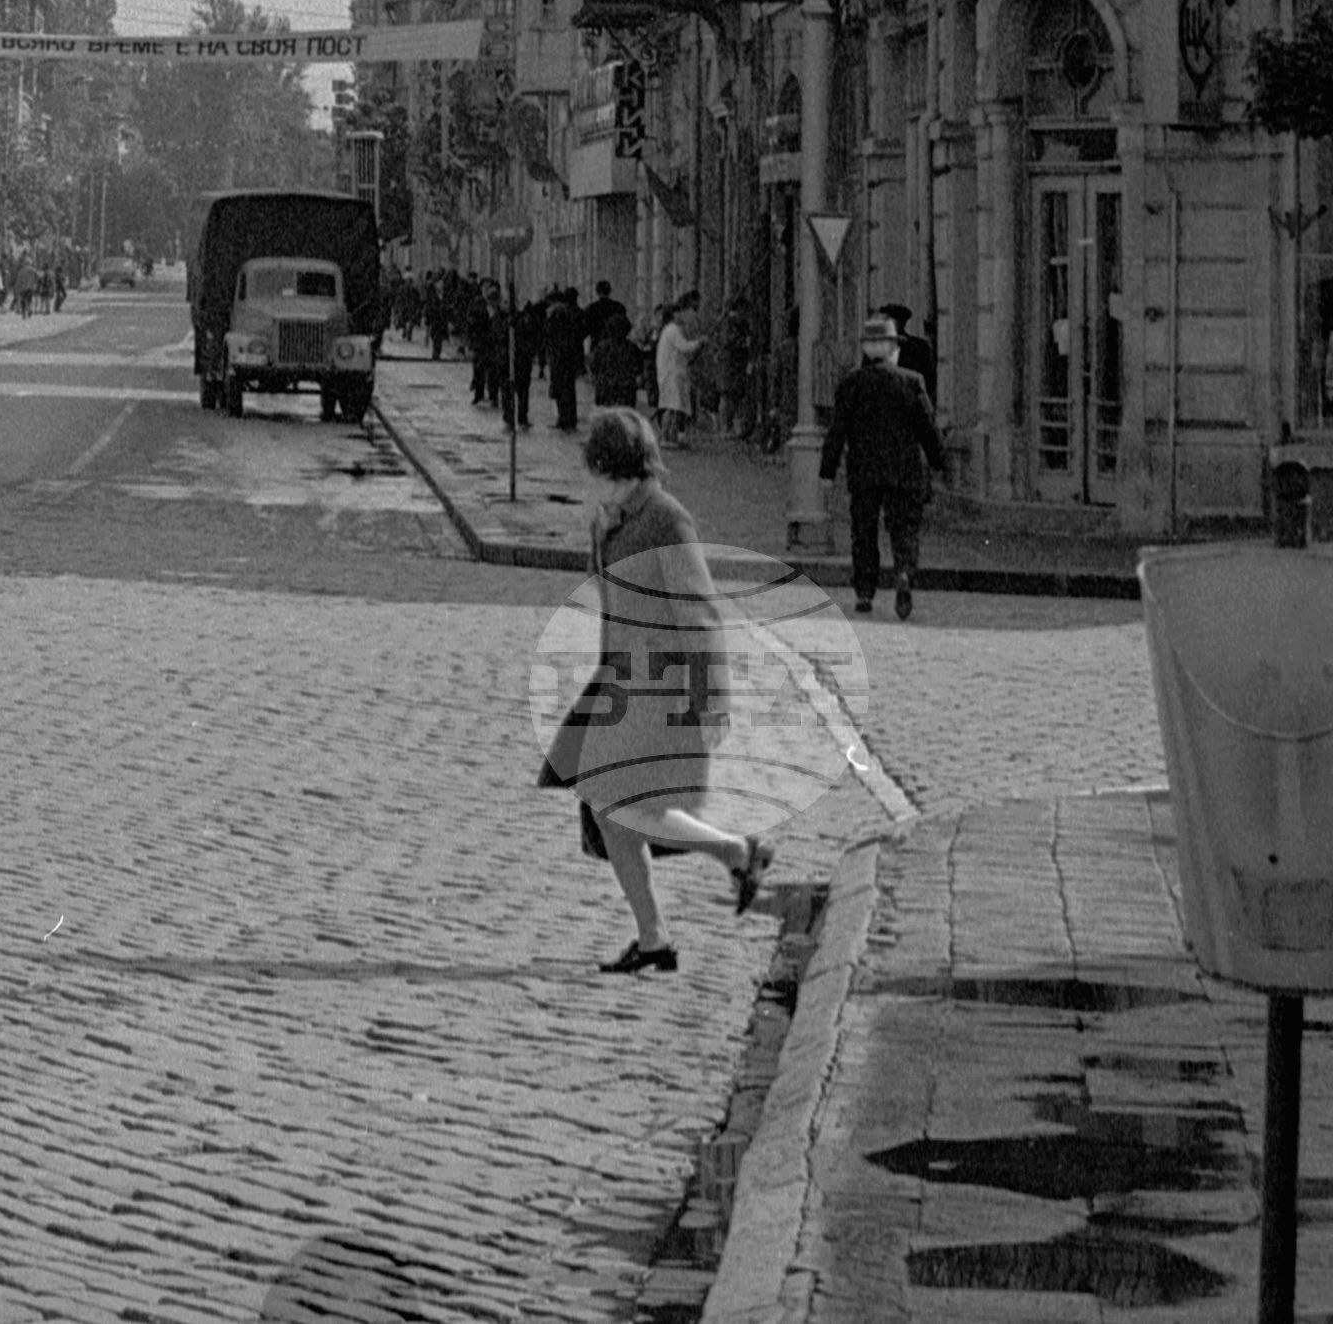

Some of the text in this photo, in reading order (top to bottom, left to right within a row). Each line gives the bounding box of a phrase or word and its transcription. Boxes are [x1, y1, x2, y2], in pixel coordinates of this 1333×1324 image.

[87, 39, 165, 56] ВРЕМЕ
[198, 39, 230, 56] НА
[236, 37, 297, 57] СВОЯ
[305, 35, 370, 57] ПОСТ
